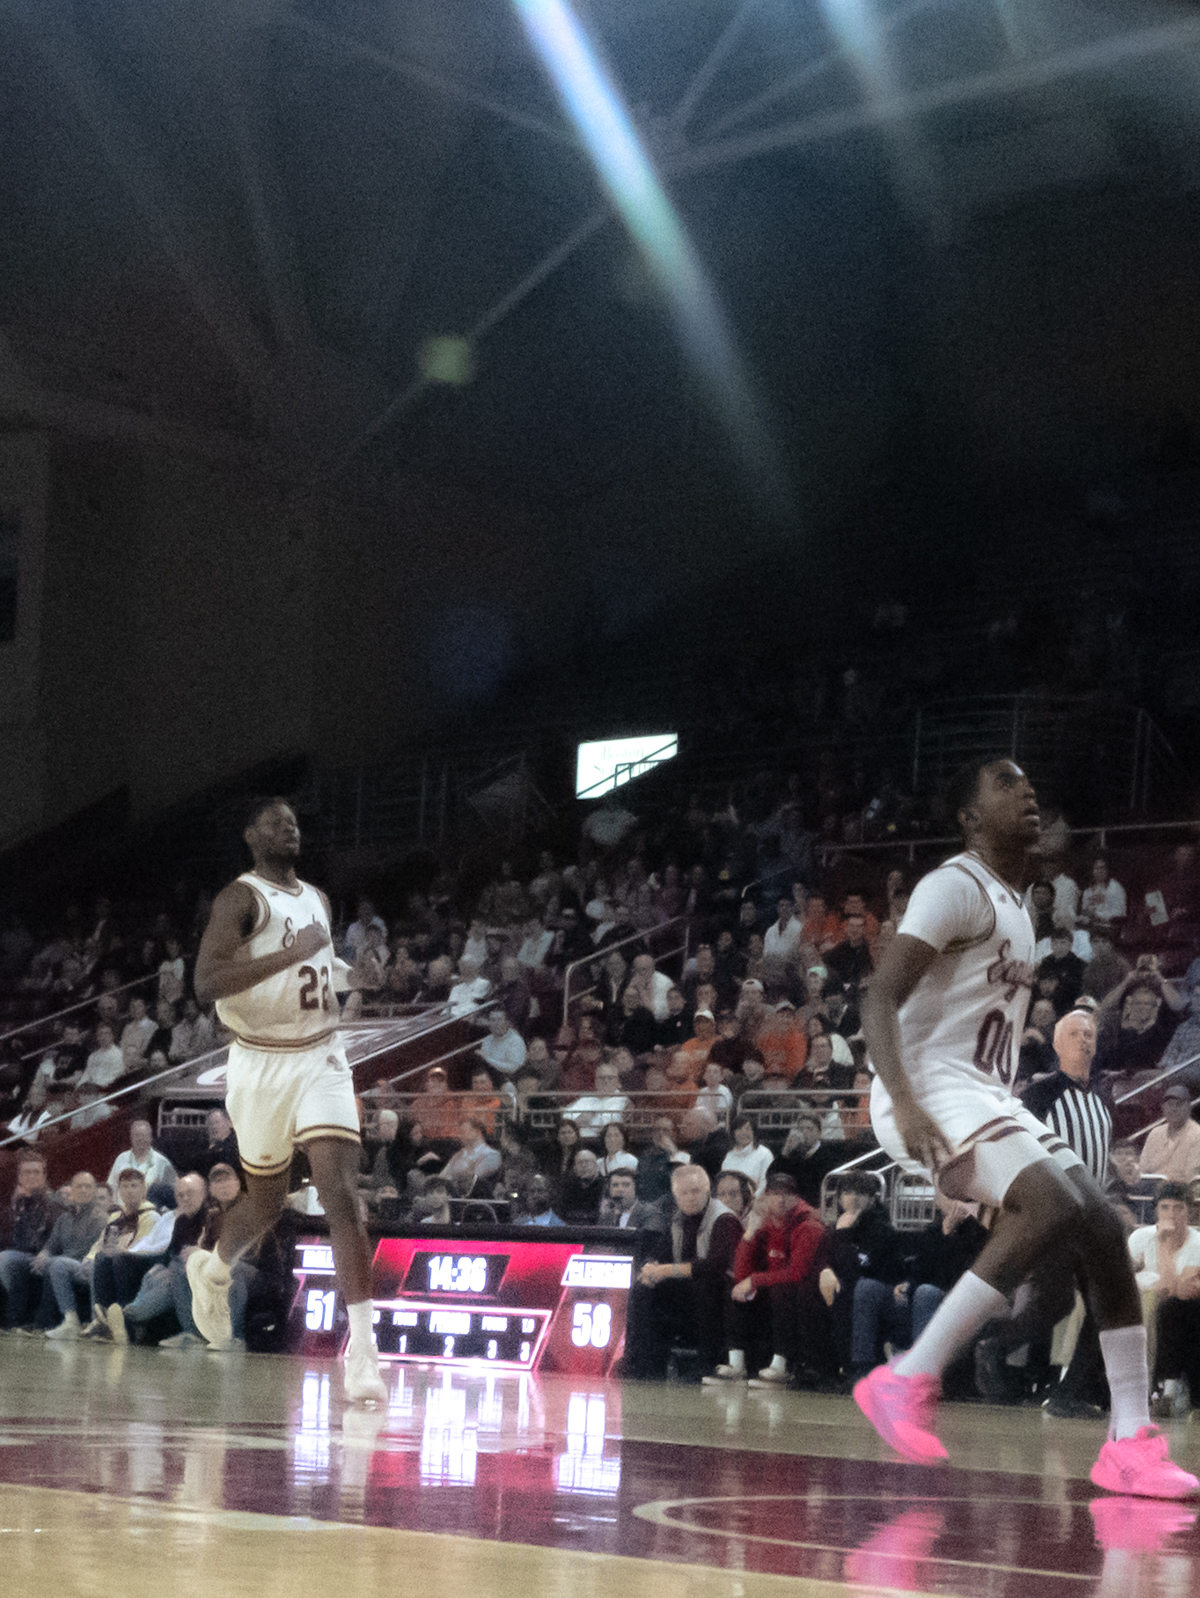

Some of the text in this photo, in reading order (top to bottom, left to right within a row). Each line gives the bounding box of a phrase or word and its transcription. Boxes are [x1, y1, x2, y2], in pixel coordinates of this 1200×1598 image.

[428, 1256, 487, 1292] 14:36
[305, 1289, 336, 1331] 51
[571, 1303, 612, 1348] 58
[399, 1334, 408, 1354] 1
[443, 1335, 455, 1359] 2
